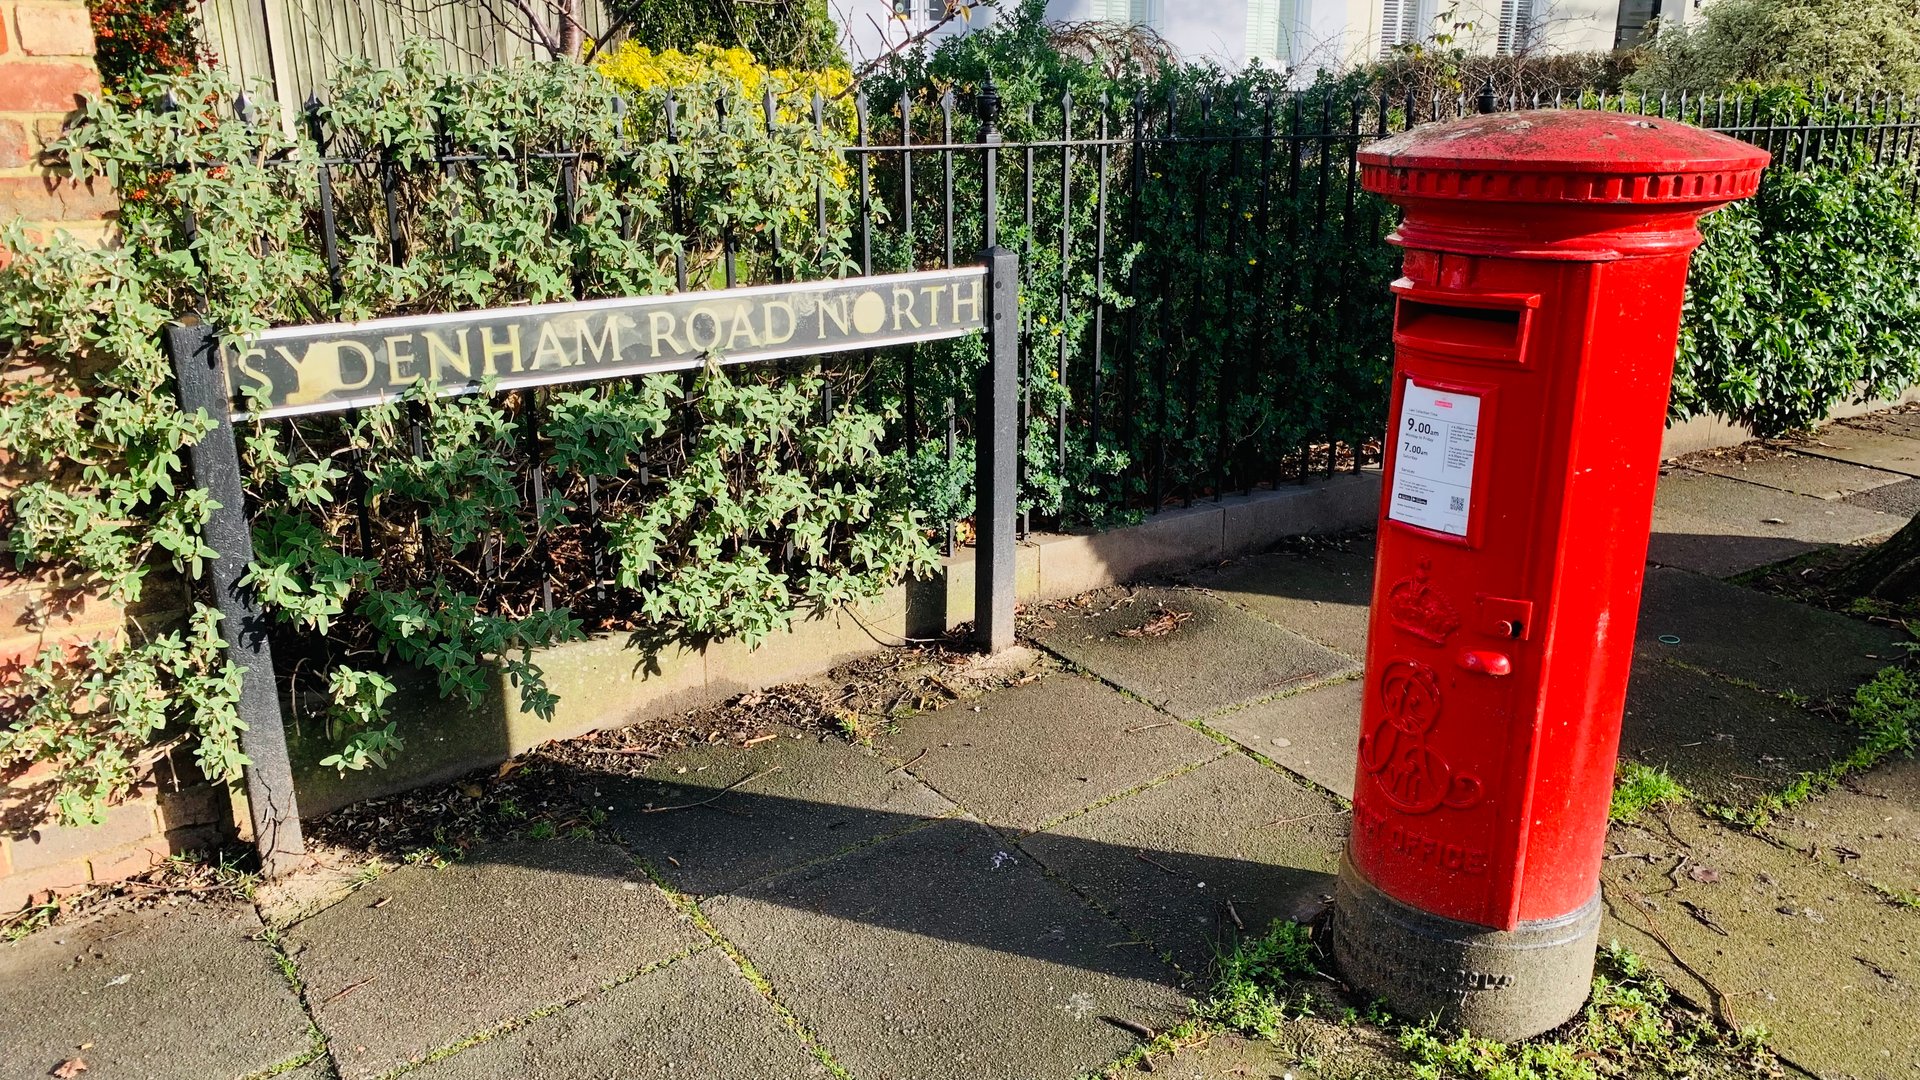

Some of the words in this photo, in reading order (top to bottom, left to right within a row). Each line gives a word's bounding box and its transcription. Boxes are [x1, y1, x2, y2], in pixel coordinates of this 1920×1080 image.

[237, 314, 624, 401] SYDENHAM
[648, 300, 797, 358] ROAD
[816, 280, 982, 340] NORTH
[1407, 417, 1439, 437] 9.00am
[1404, 442, 1429, 456] 7.00am
[1390, 825, 1489, 874] OFFICE
